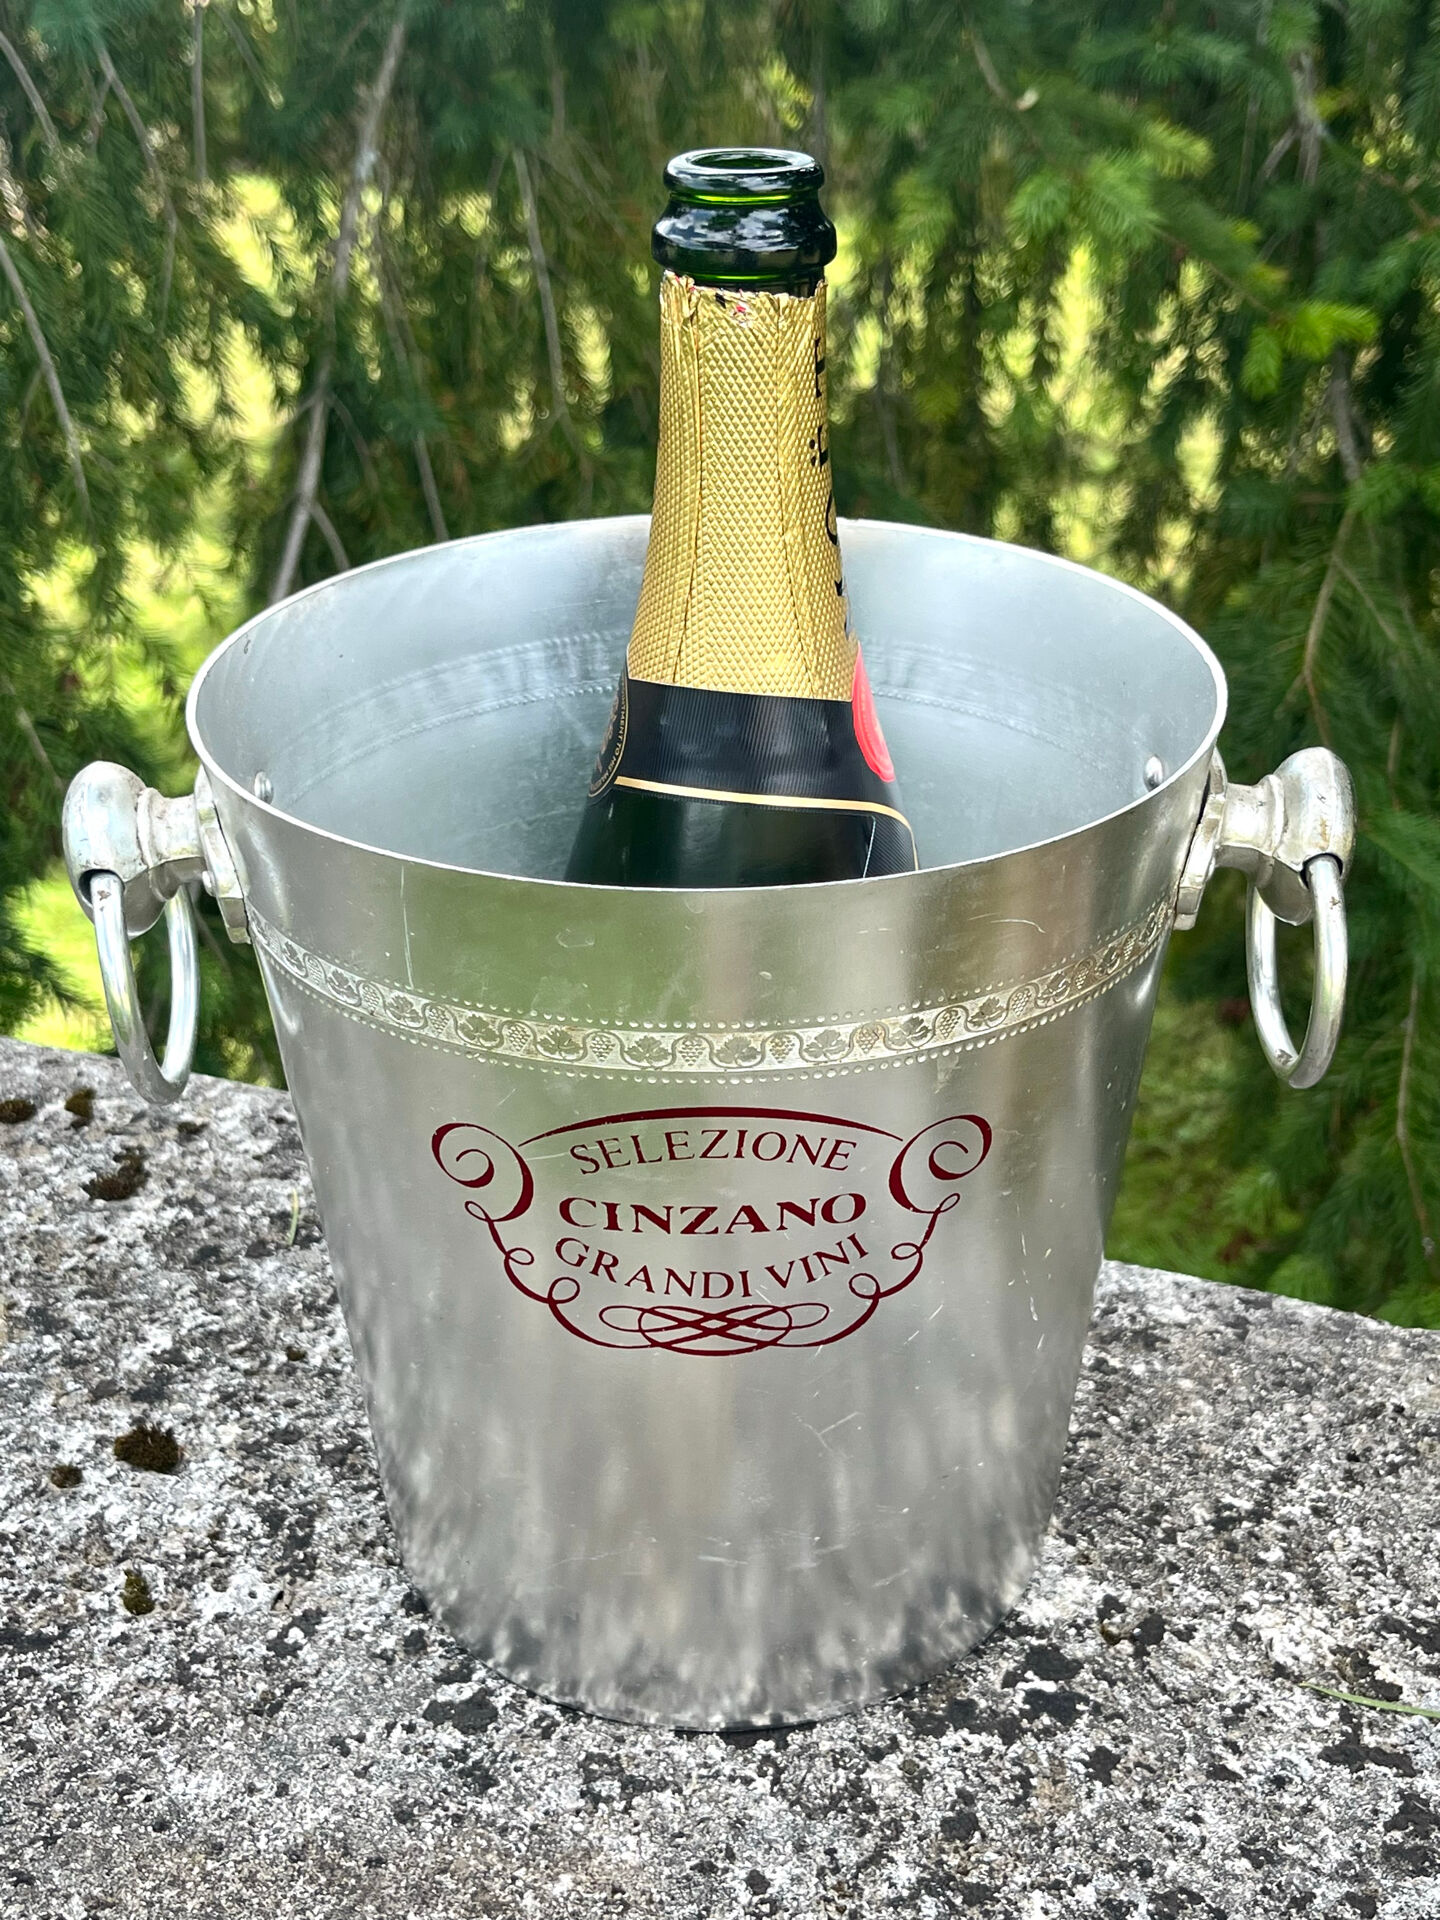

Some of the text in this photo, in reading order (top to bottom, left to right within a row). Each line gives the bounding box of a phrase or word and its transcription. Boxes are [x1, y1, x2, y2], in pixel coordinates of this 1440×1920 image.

[570, 1129, 858, 1175] SELEZIONE
[559, 1193, 867, 1235] CINZANO
[555, 1233, 869, 1299] GRANDI VINI
